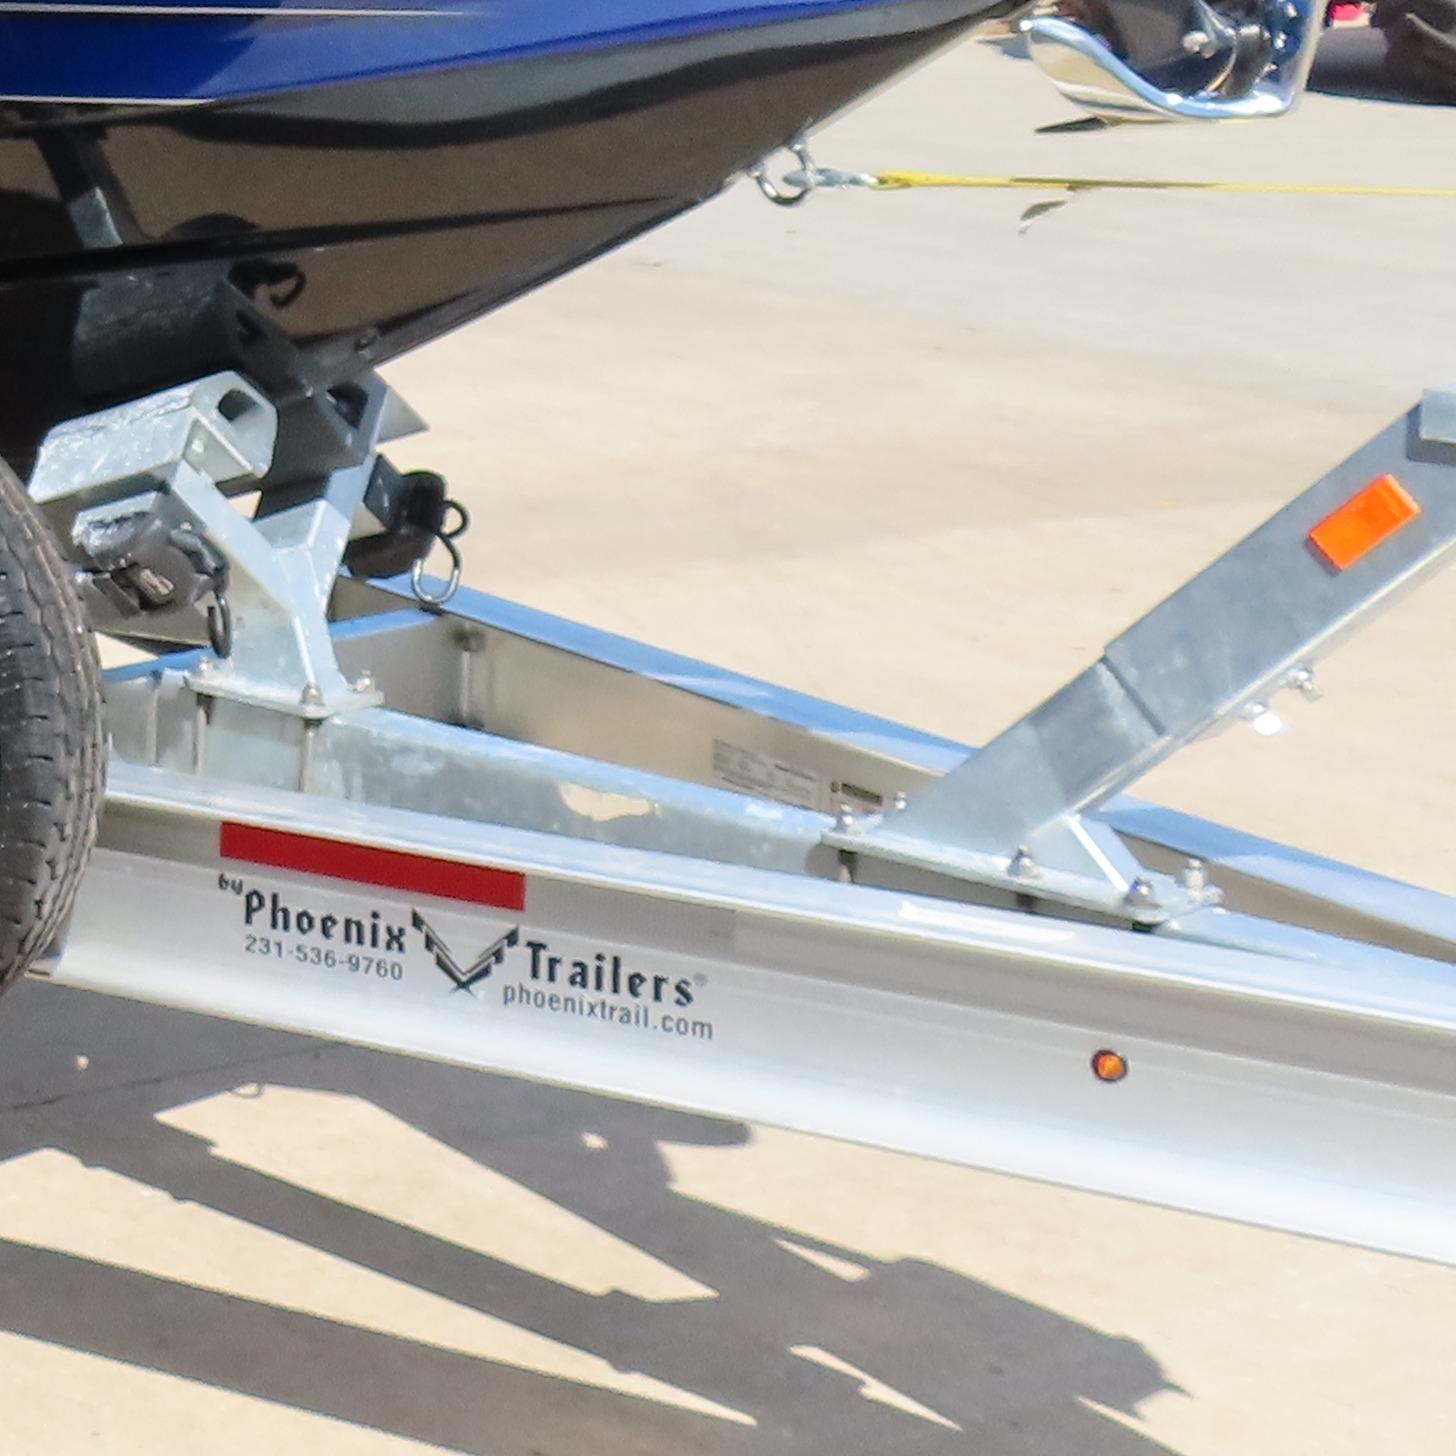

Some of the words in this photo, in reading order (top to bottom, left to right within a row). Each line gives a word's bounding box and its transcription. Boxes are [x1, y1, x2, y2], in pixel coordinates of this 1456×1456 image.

[244, 889, 406, 954] Phoenix
[244, 933, 404, 982] 231-536-9760
[503, 982, 714, 1040] phoenixtrail.com
